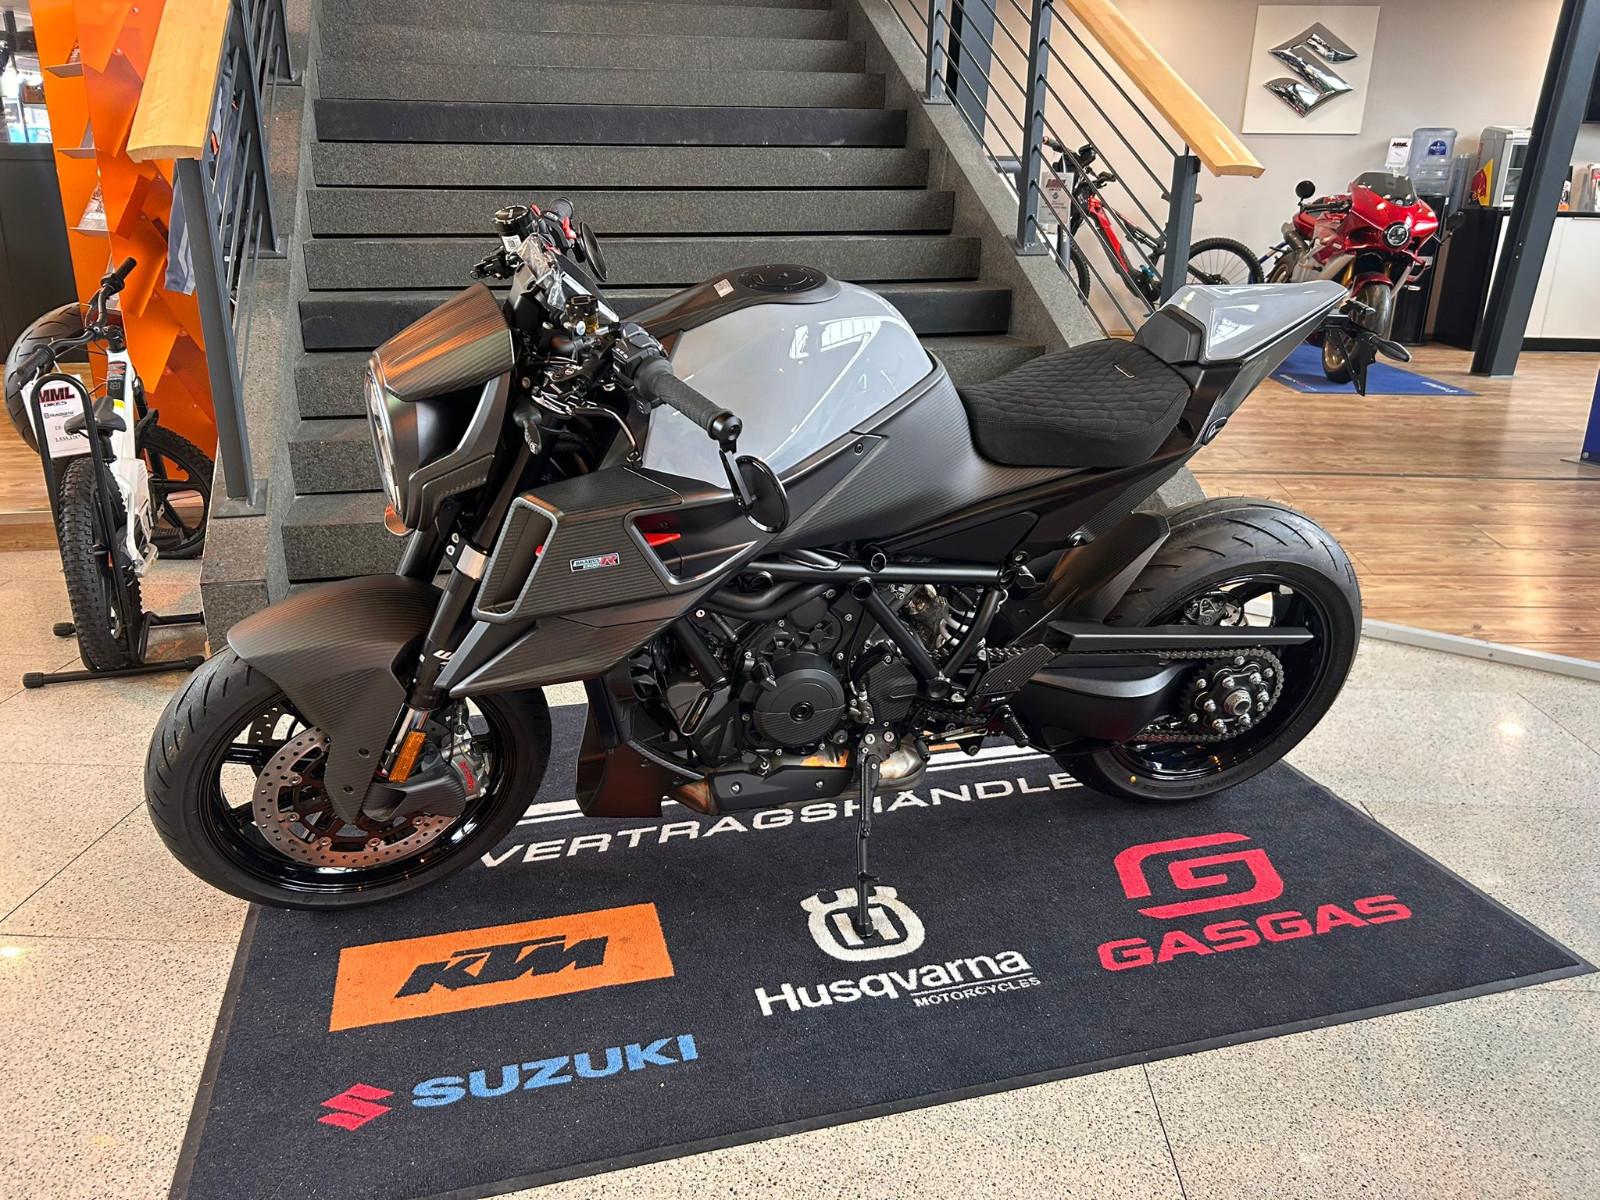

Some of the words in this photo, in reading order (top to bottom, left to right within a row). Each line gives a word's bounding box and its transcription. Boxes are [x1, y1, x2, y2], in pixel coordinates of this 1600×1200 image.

[1097, 894, 1412, 971] GASGAS
[394, 935, 609, 998] KTM
[754, 950, 1031, 1016] Husqvarna
[913, 977, 1041, 1007] MOTORCYCLES
[411, 1033, 698, 1098] SUZUKI
